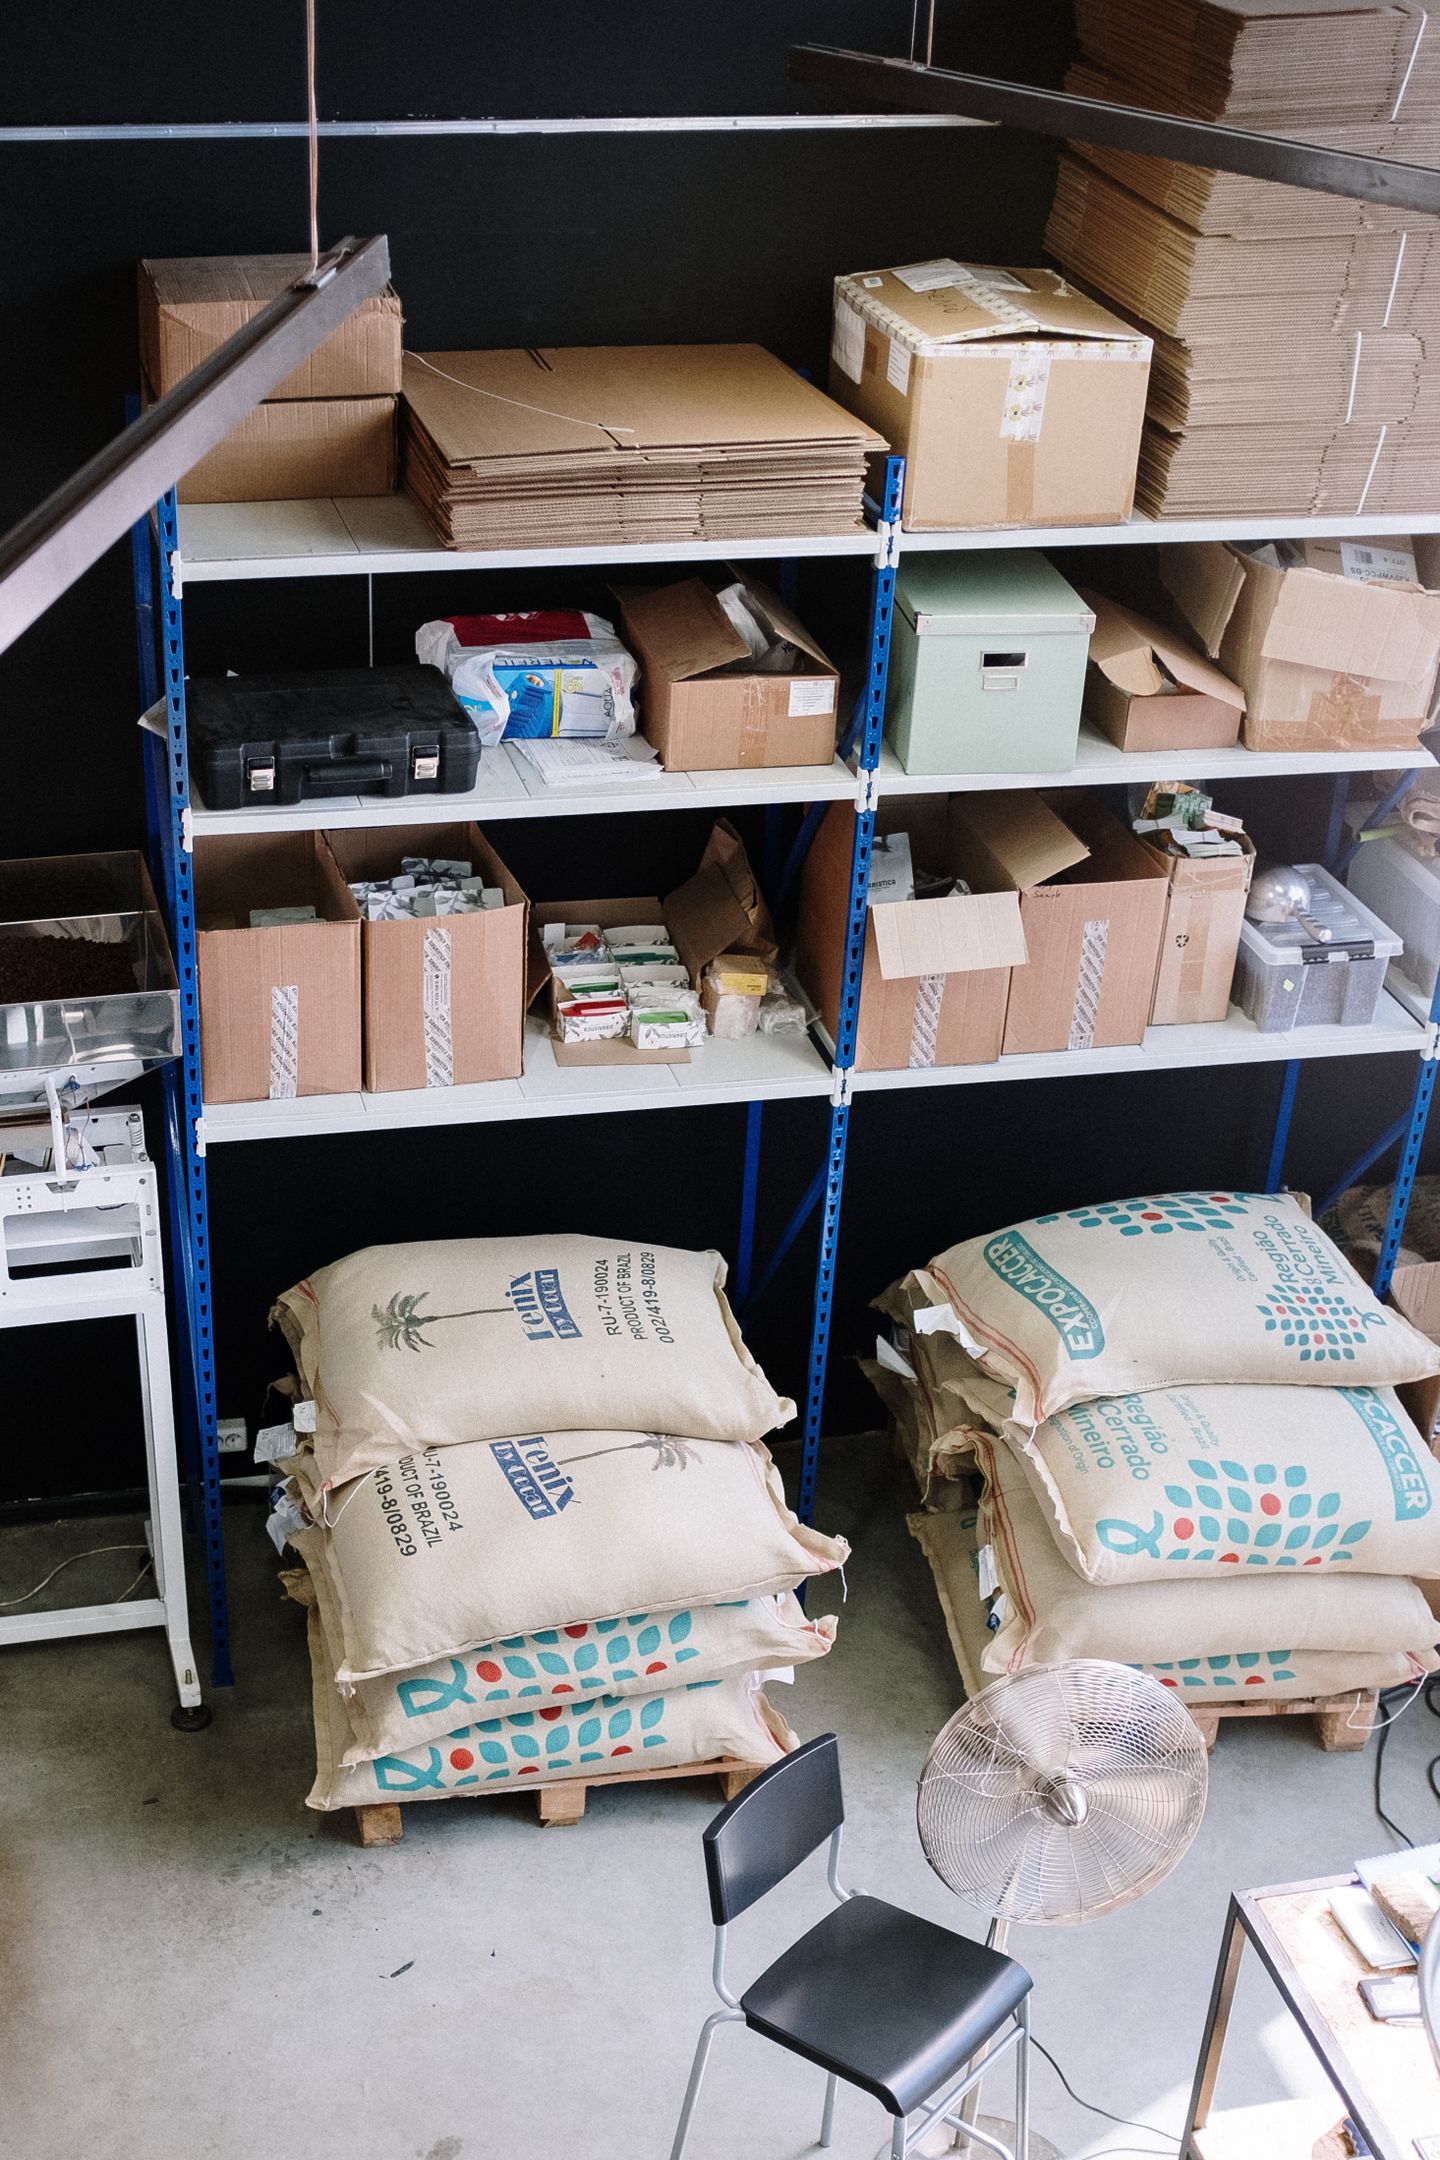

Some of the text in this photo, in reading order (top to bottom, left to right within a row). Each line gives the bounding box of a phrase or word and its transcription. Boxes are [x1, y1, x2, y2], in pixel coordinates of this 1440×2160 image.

[602, 687, 615, 718] AQUA
[867, 879, 896, 888] ARISTICA
[1252, 1231, 1299, 1283] Região
[1264, 1215, 1314, 1276] Cerrado
[1294, 1225, 1344, 1285] Mineiro
[505, 1271, 554, 1340] Fenix
[540, 1272, 562, 1313] Cocar
[594, 1259, 622, 1336] RU-7-190024
[617, 1253, 648, 1340] PRODUCT OF BRAZIL
[640, 1251, 674, 1344] 002/419-8/0829
[988, 1237, 1095, 1351] EXPOCACCER
[1049, 1415, 1073, 1446] signation
[1096, 1403, 1152, 1480] Cerrado
[1353, 1387, 1428, 1509] OCACCER
[398, 1455, 442, 1548] DUCT OF BRAZIL
[422, 1447, 463, 1532] U-7-190024
[507, 1465, 551, 1514] Cocar
[517, 1436, 581, 1512] Fenix
